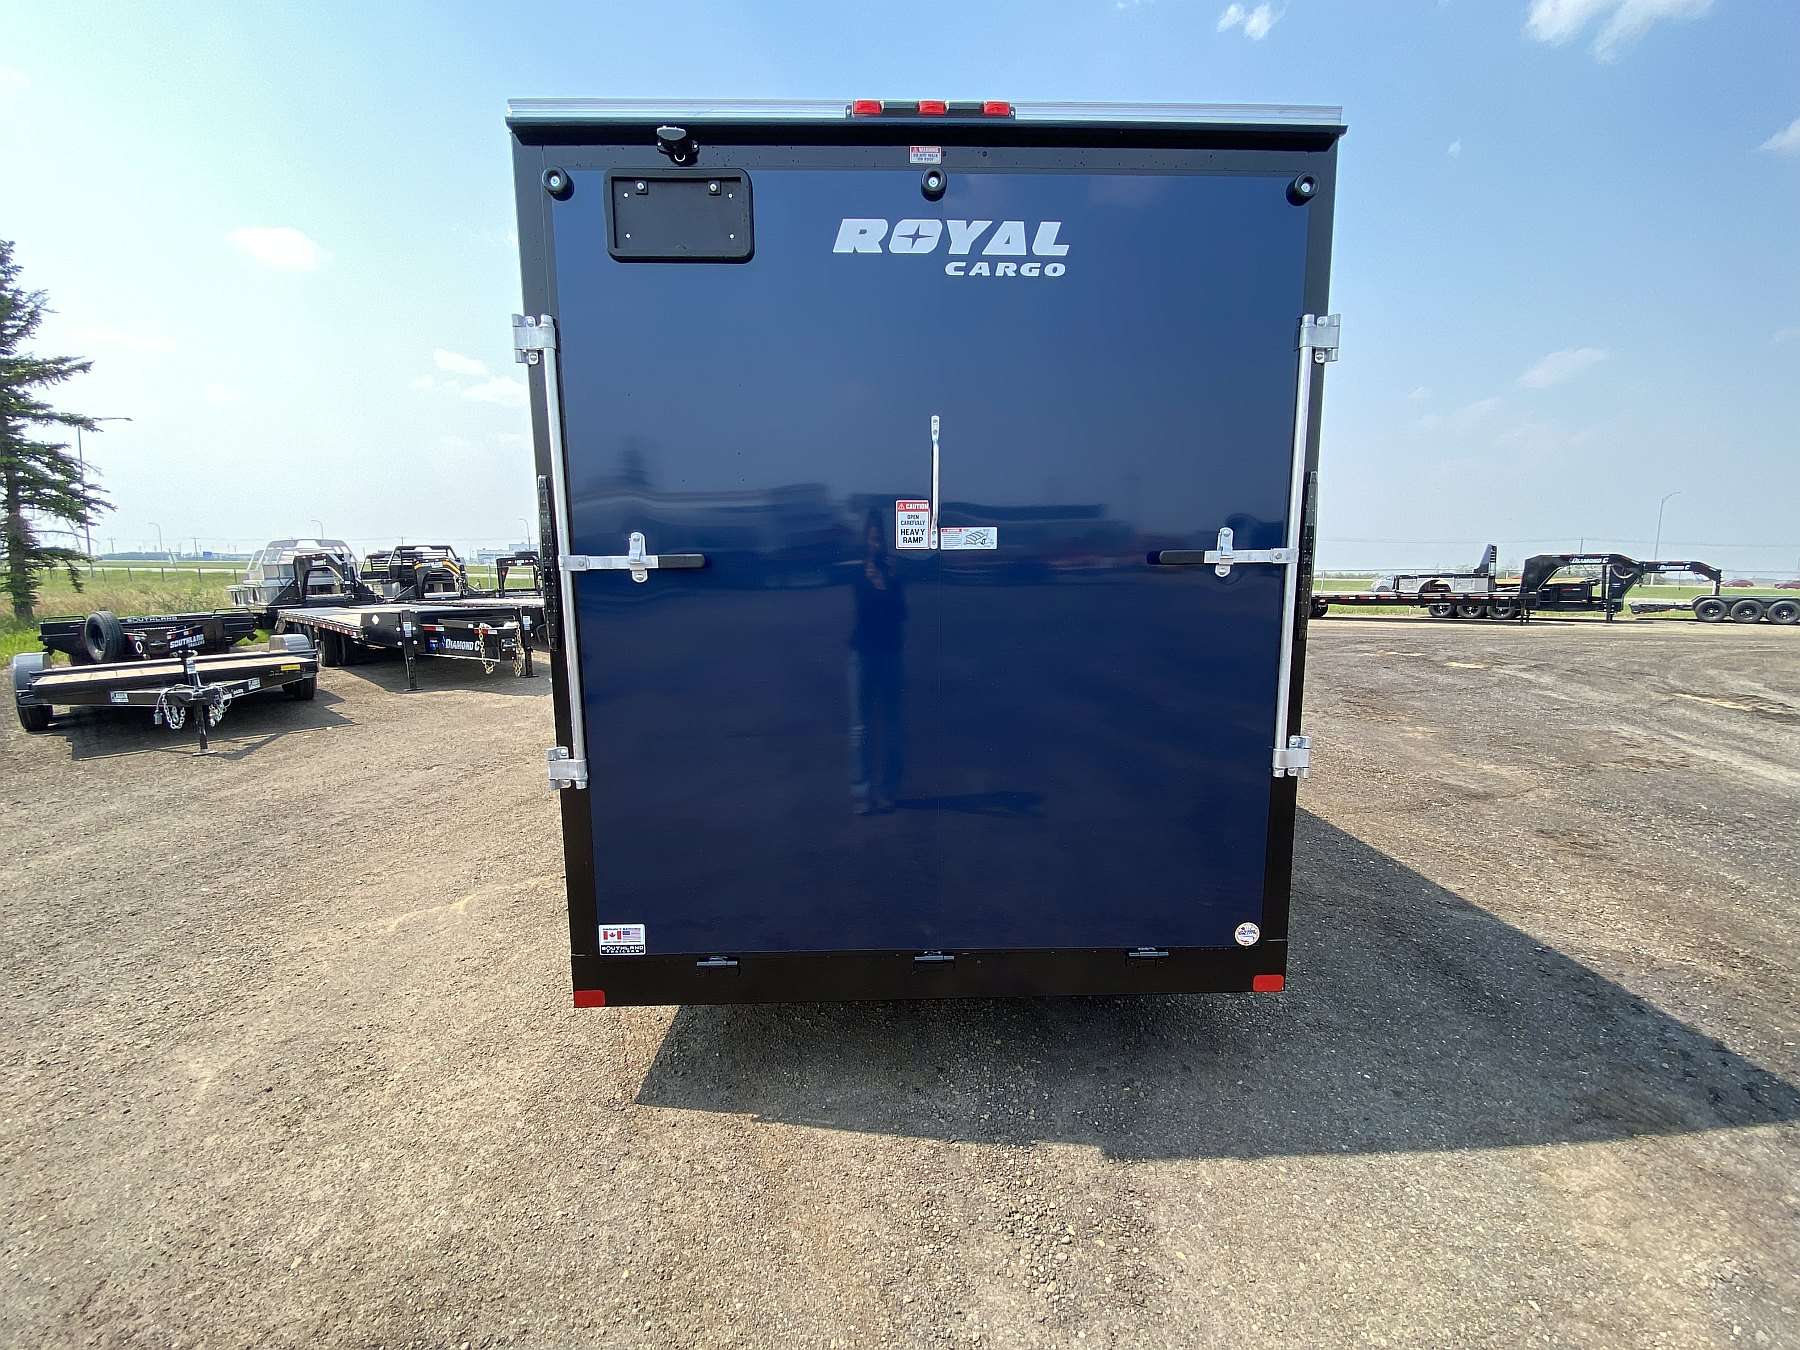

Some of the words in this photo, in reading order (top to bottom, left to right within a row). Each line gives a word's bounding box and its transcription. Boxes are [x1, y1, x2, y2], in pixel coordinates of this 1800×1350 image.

[832, 218, 1070, 256] ROYAL
[944, 261, 1066, 277] CARGO
[900, 528, 926, 536] HEAVY
[902, 536, 924, 544] RAMP
[169, 633, 204, 649] SOUTHLAND
[445, 638, 474, 651] DIAMOND
[474, 640, 480, 651] C
